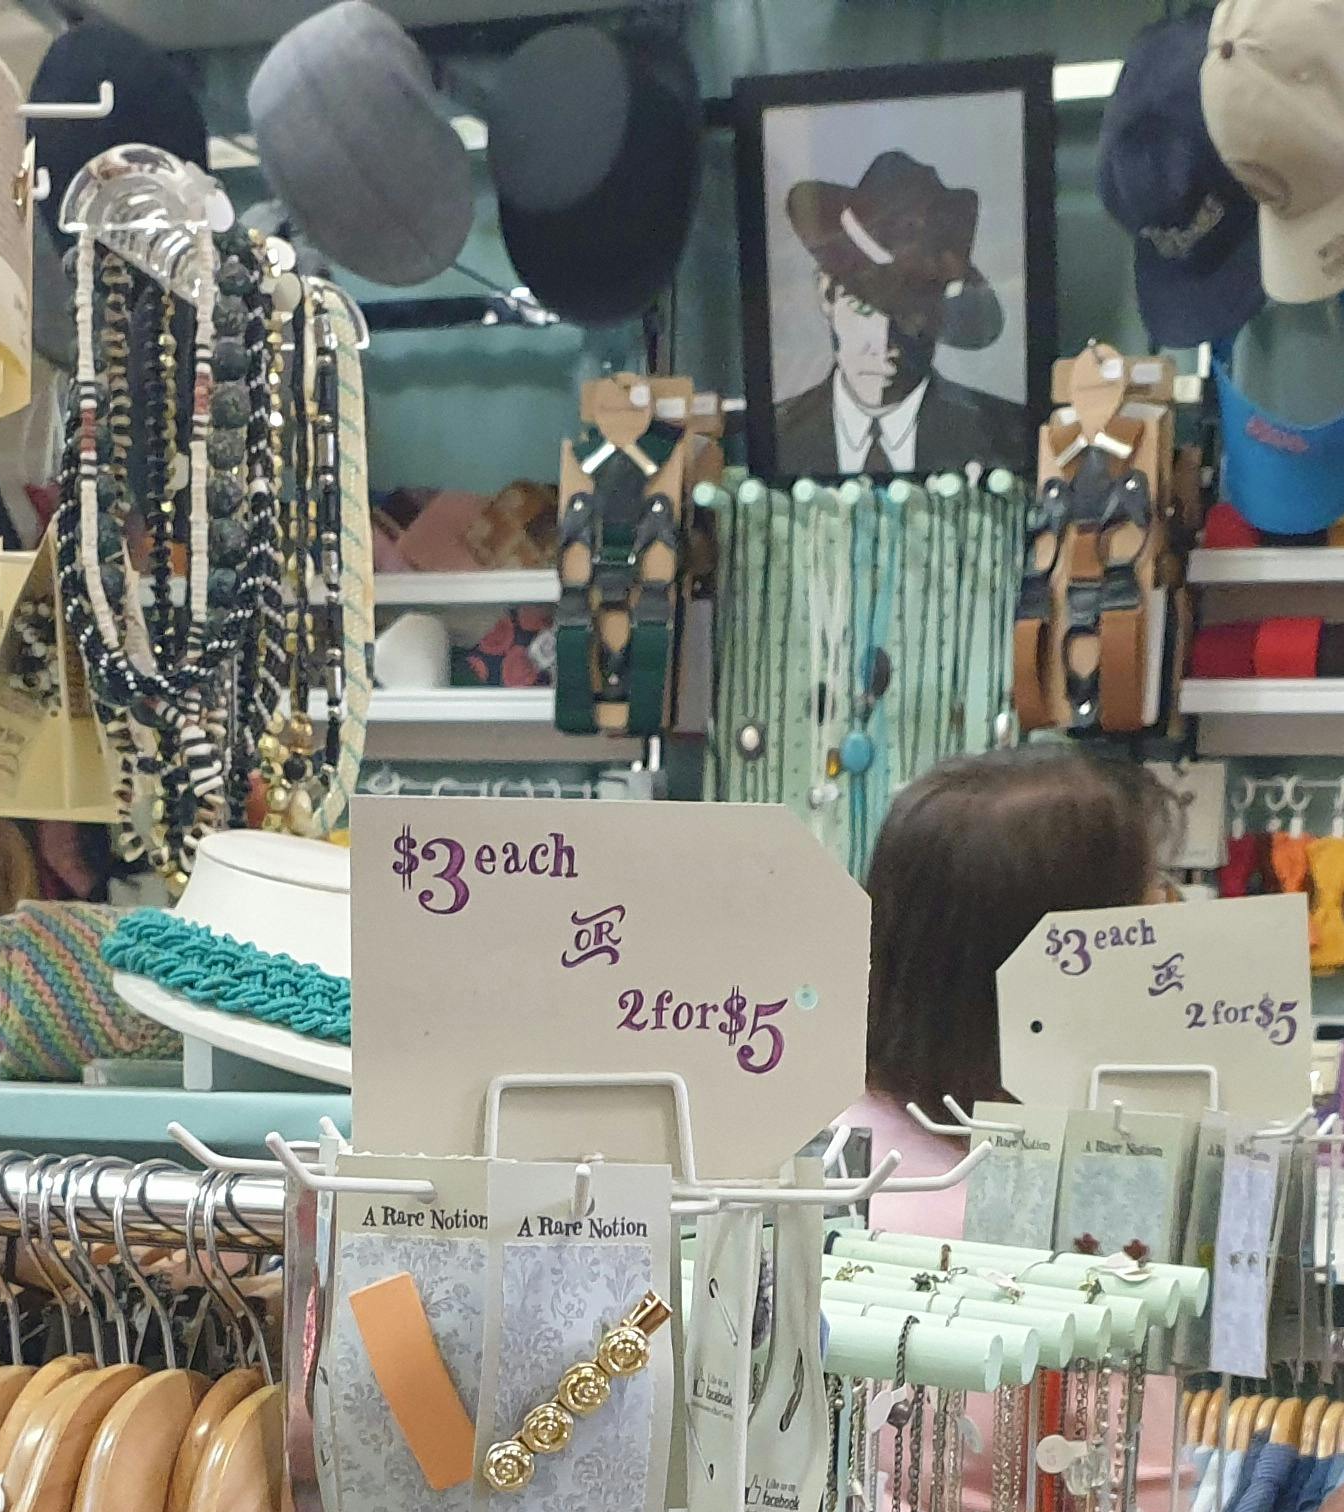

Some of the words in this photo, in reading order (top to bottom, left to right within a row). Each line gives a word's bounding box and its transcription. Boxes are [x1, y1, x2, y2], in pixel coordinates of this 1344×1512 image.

[392, 824, 471, 915] $3
[473, 833, 579, 879] each
[573, 920, 623, 953] OR
[1044, 920, 1092, 976] $3
[1093, 917, 1157, 950] each
[650, 989, 719, 1032] for
[718, 984, 789, 1075] $5
[1185, 1002, 1207, 1030] 2
[1212, 999, 1255, 1026] for
[1255, 991, 1300, 1046] $5
[362, 1205, 377, 1227] A
[381, 1205, 425, 1227] Rare
[429, 1209, 488, 1231] Notion
[516, 1216, 534, 1238] A
[537, 1216, 583, 1238] Rare
[588, 1217, 648, 1239] Notion
[762, 1490, 800, 1511] facebook
